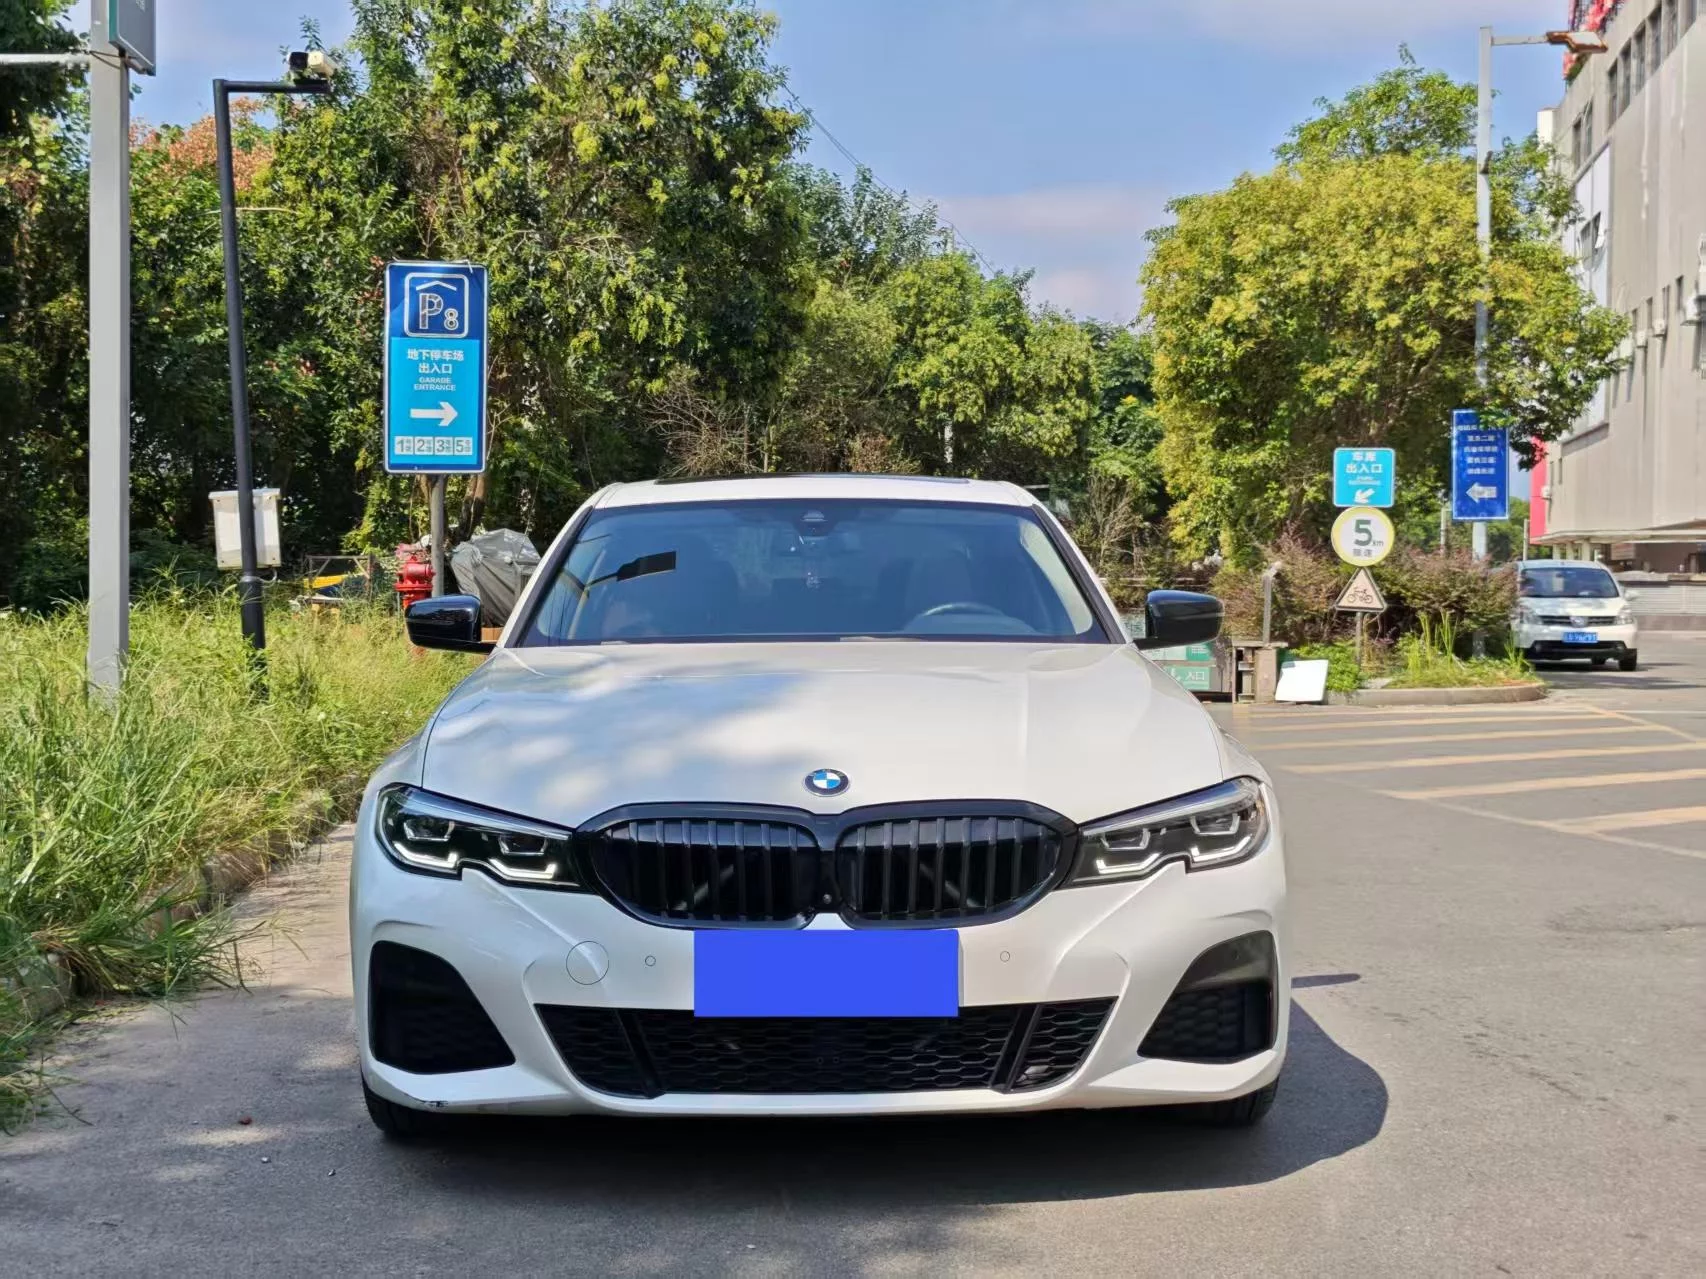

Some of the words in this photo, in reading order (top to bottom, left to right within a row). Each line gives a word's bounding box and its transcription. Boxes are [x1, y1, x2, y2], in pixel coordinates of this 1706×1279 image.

[407, 349, 464, 361] 地下停车场
[418, 363, 452, 374] 出入口
[1346, 463, 1383, 473] 出入口
[1353, 519, 1373, 546] 5
